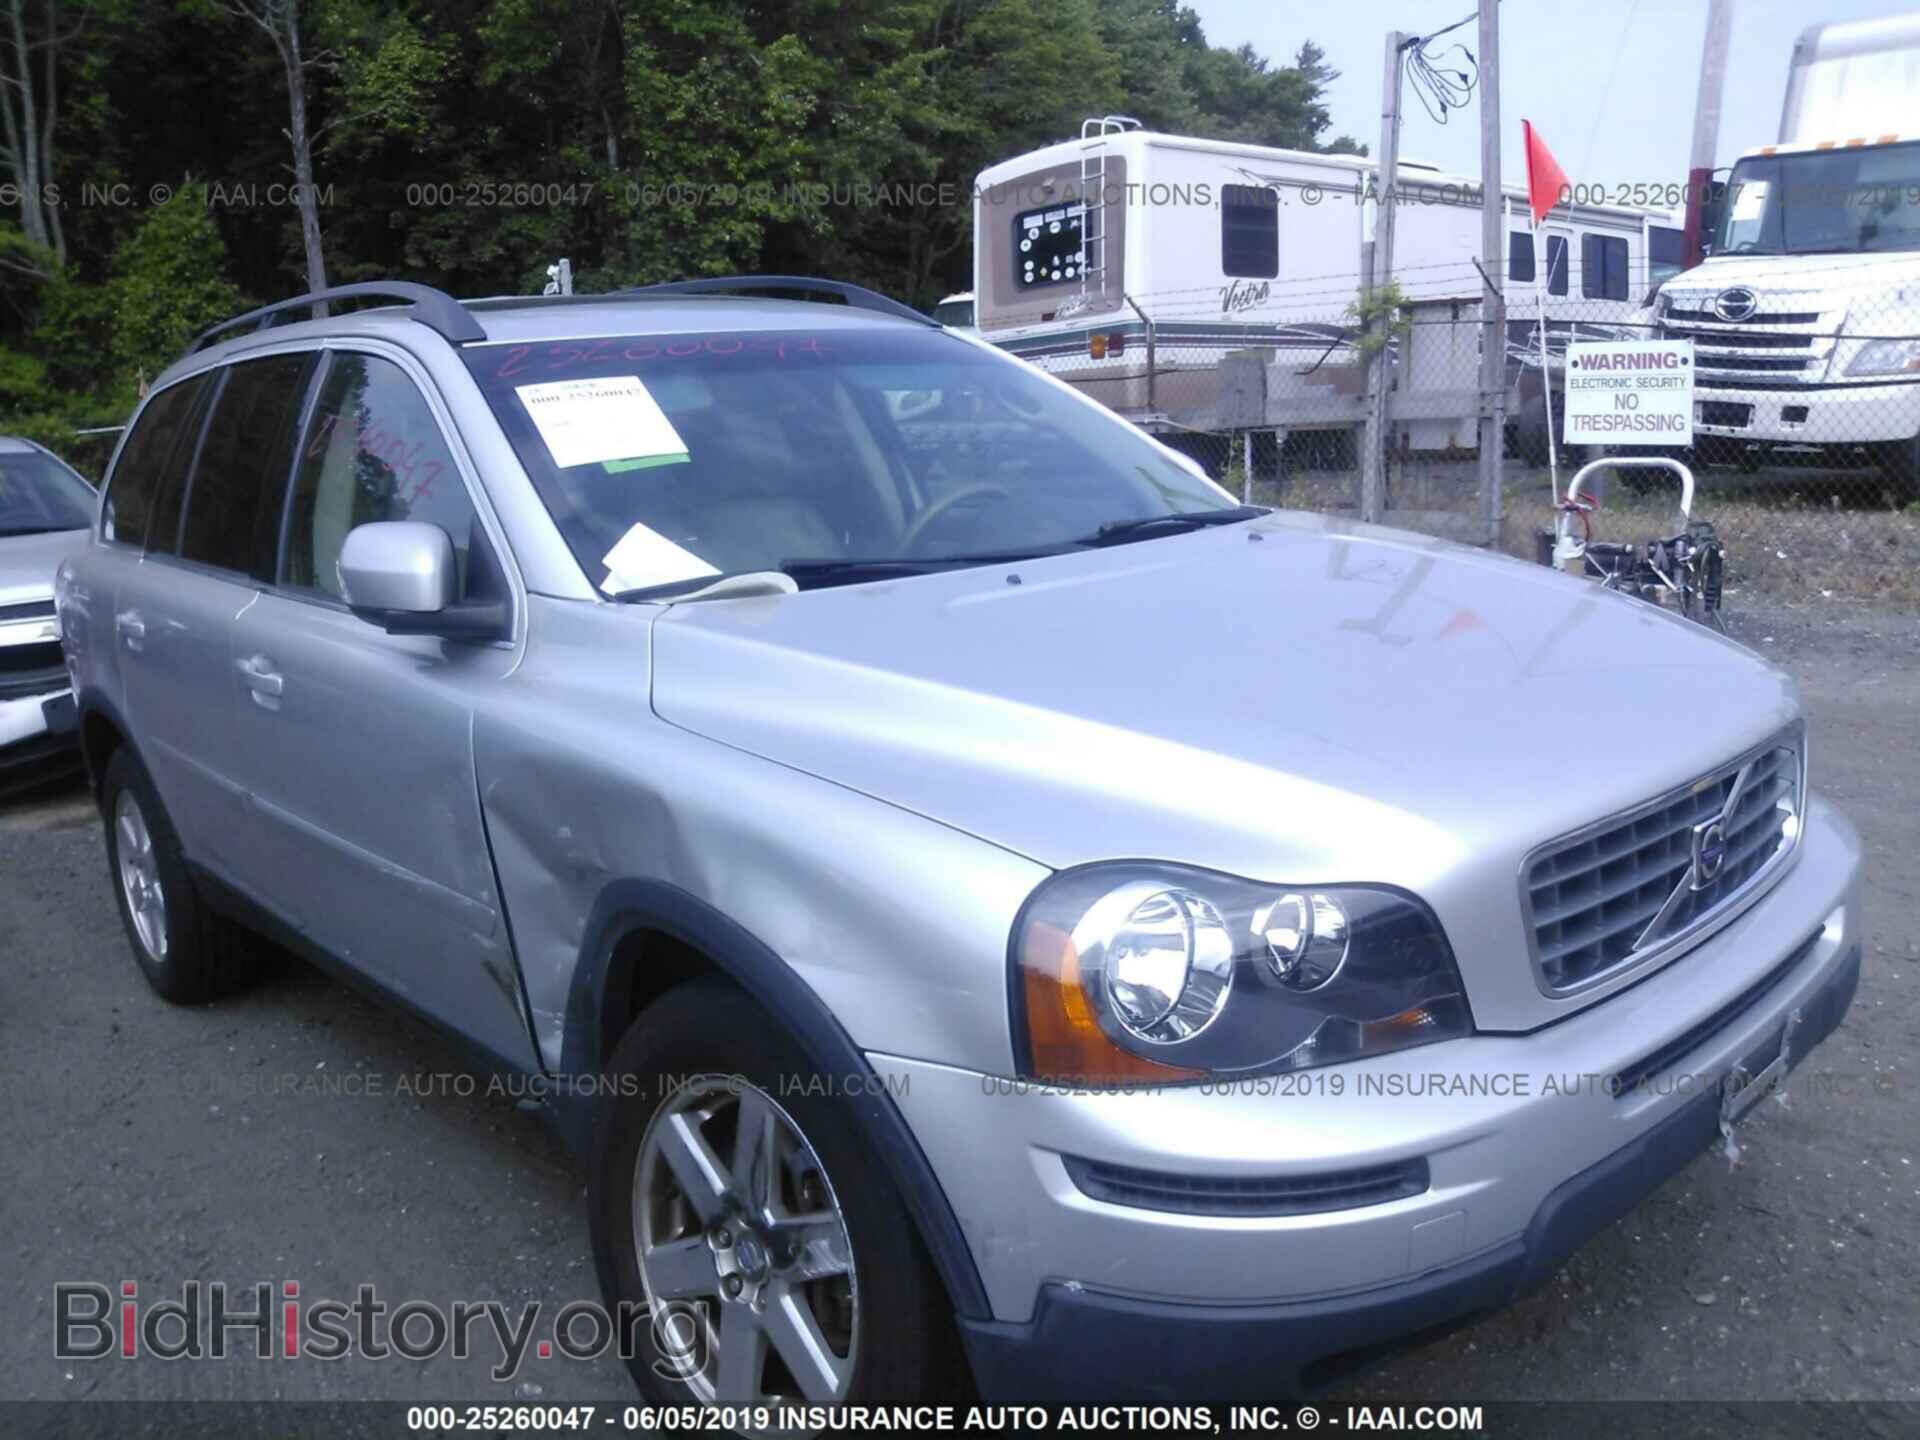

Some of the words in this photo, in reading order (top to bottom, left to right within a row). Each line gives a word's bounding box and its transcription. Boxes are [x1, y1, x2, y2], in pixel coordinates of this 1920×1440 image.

[1219, 279, 1270, 312] Vectra
[1580, 352, 1679, 370] WARNING
[1570, 378, 1632, 389] ELECTRONIC
[1636, 377, 1686, 388] SECURITY
[1614, 393, 1640, 410] NO
[1571, 414, 1685, 432] TRESPASSING
